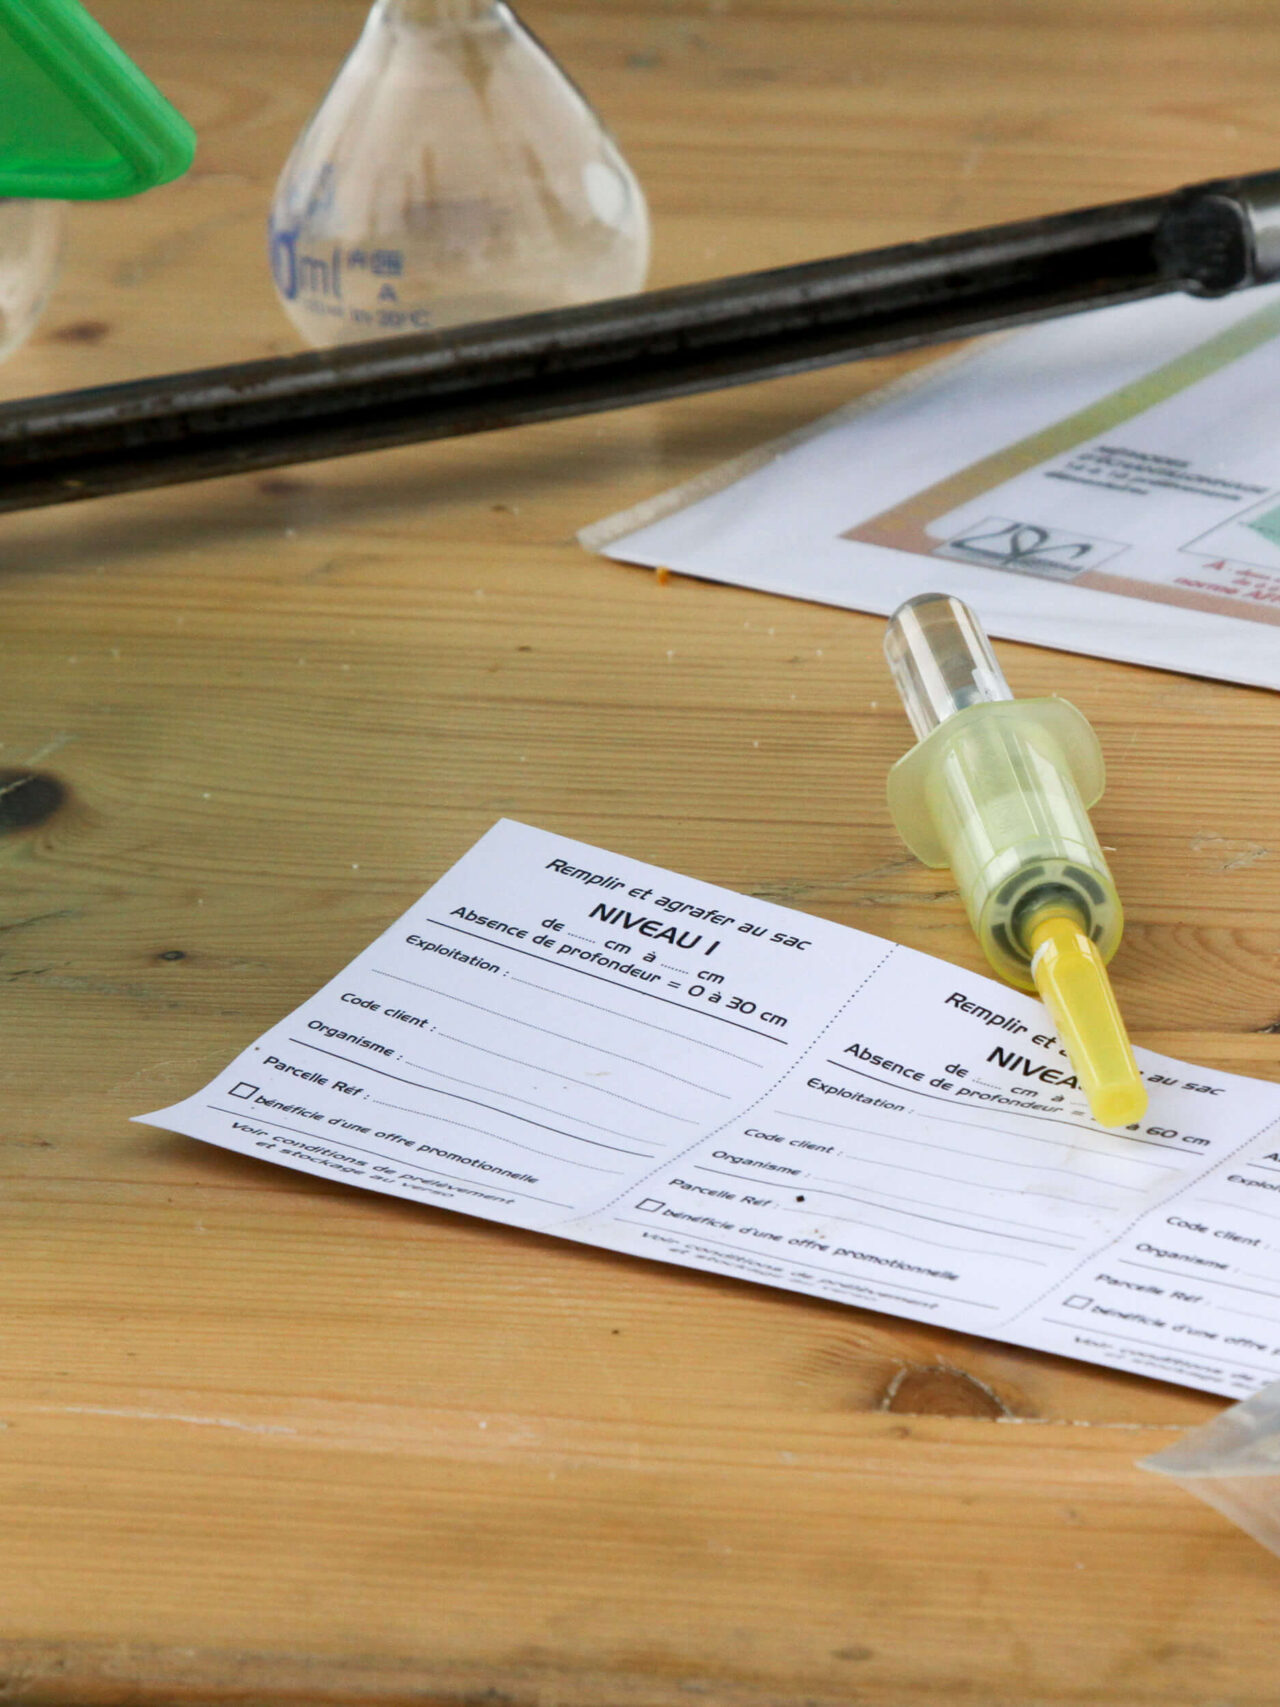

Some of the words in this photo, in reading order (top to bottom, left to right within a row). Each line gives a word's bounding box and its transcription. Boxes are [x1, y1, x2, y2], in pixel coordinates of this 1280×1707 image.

[545, 858, 626, 890] Remplir
[627, 887, 653, 901] et
[654, 896, 736, 926] agrafer
[737, 922, 768, 937] au
[769, 932, 813, 951] sac
[588, 902, 703, 949] NIVEAU
[405, 934, 501, 974] Exploitation
[449, 906, 529, 939] Absence
[531, 934, 556, 949] de
[556, 944, 662, 983] profondeur
[687, 984, 706, 997] 0
[707, 991, 722, 1004] à
[725, 996, 757, 1015] 30
[759, 1011, 788, 1028] cm
[541, 918, 565, 932] de
[604, 940, 632, 955] cm
[642, 951, 657, 963] à
[697, 970, 725, 985] cm
[340, 992, 381, 1012] Code
[383, 1008, 429, 1029] client
[307, 1020, 395, 1057] Organisme
[944, 991, 1029, 1034] Remplir
[1031, 1034, 1057, 1049] et
[1146, 1074, 1179, 1086] au
[1180, 1082, 1226, 1096] sac
[262, 1055, 329, 1086] Parcelle
[331, 1080, 365, 1096] Réf
[944, 1063, 969, 1079] de
[1010, 1086, 1039, 1098] cm
[986, 1046, 1082, 1090] NIVEA
[806, 1077, 905, 1112] Exploitation
[843, 1043, 925, 1082] Absence
[929, 1077, 954, 1091] de
[954, 1087, 1064, 1113] profondeur
[1145, 1126, 1179, 1139] 60
[1181, 1135, 1211, 1147] cm
[231, 1121, 269, 1136] Voir
[272, 1136, 368, 1167] conditions
[372, 1165, 397, 1175] de
[253, 1095, 325, 1121] bénéficie
[327, 1118, 372, 1134] d'une
[374, 1131, 416, 1147] offre
[416, 1144, 539, 1184] promotionnelle
[255, 1141, 277, 1150] et
[743, 1128, 785, 1143] Code
[788, 1140, 835, 1154] client
[711, 1150, 802, 1176] Organisme
[668, 1178, 736, 1200] Parcelle
[738, 1227, 783, 1242] d'une
[787, 1238, 830, 1252] offre
[832, 1247, 959, 1281] promotionnelle
